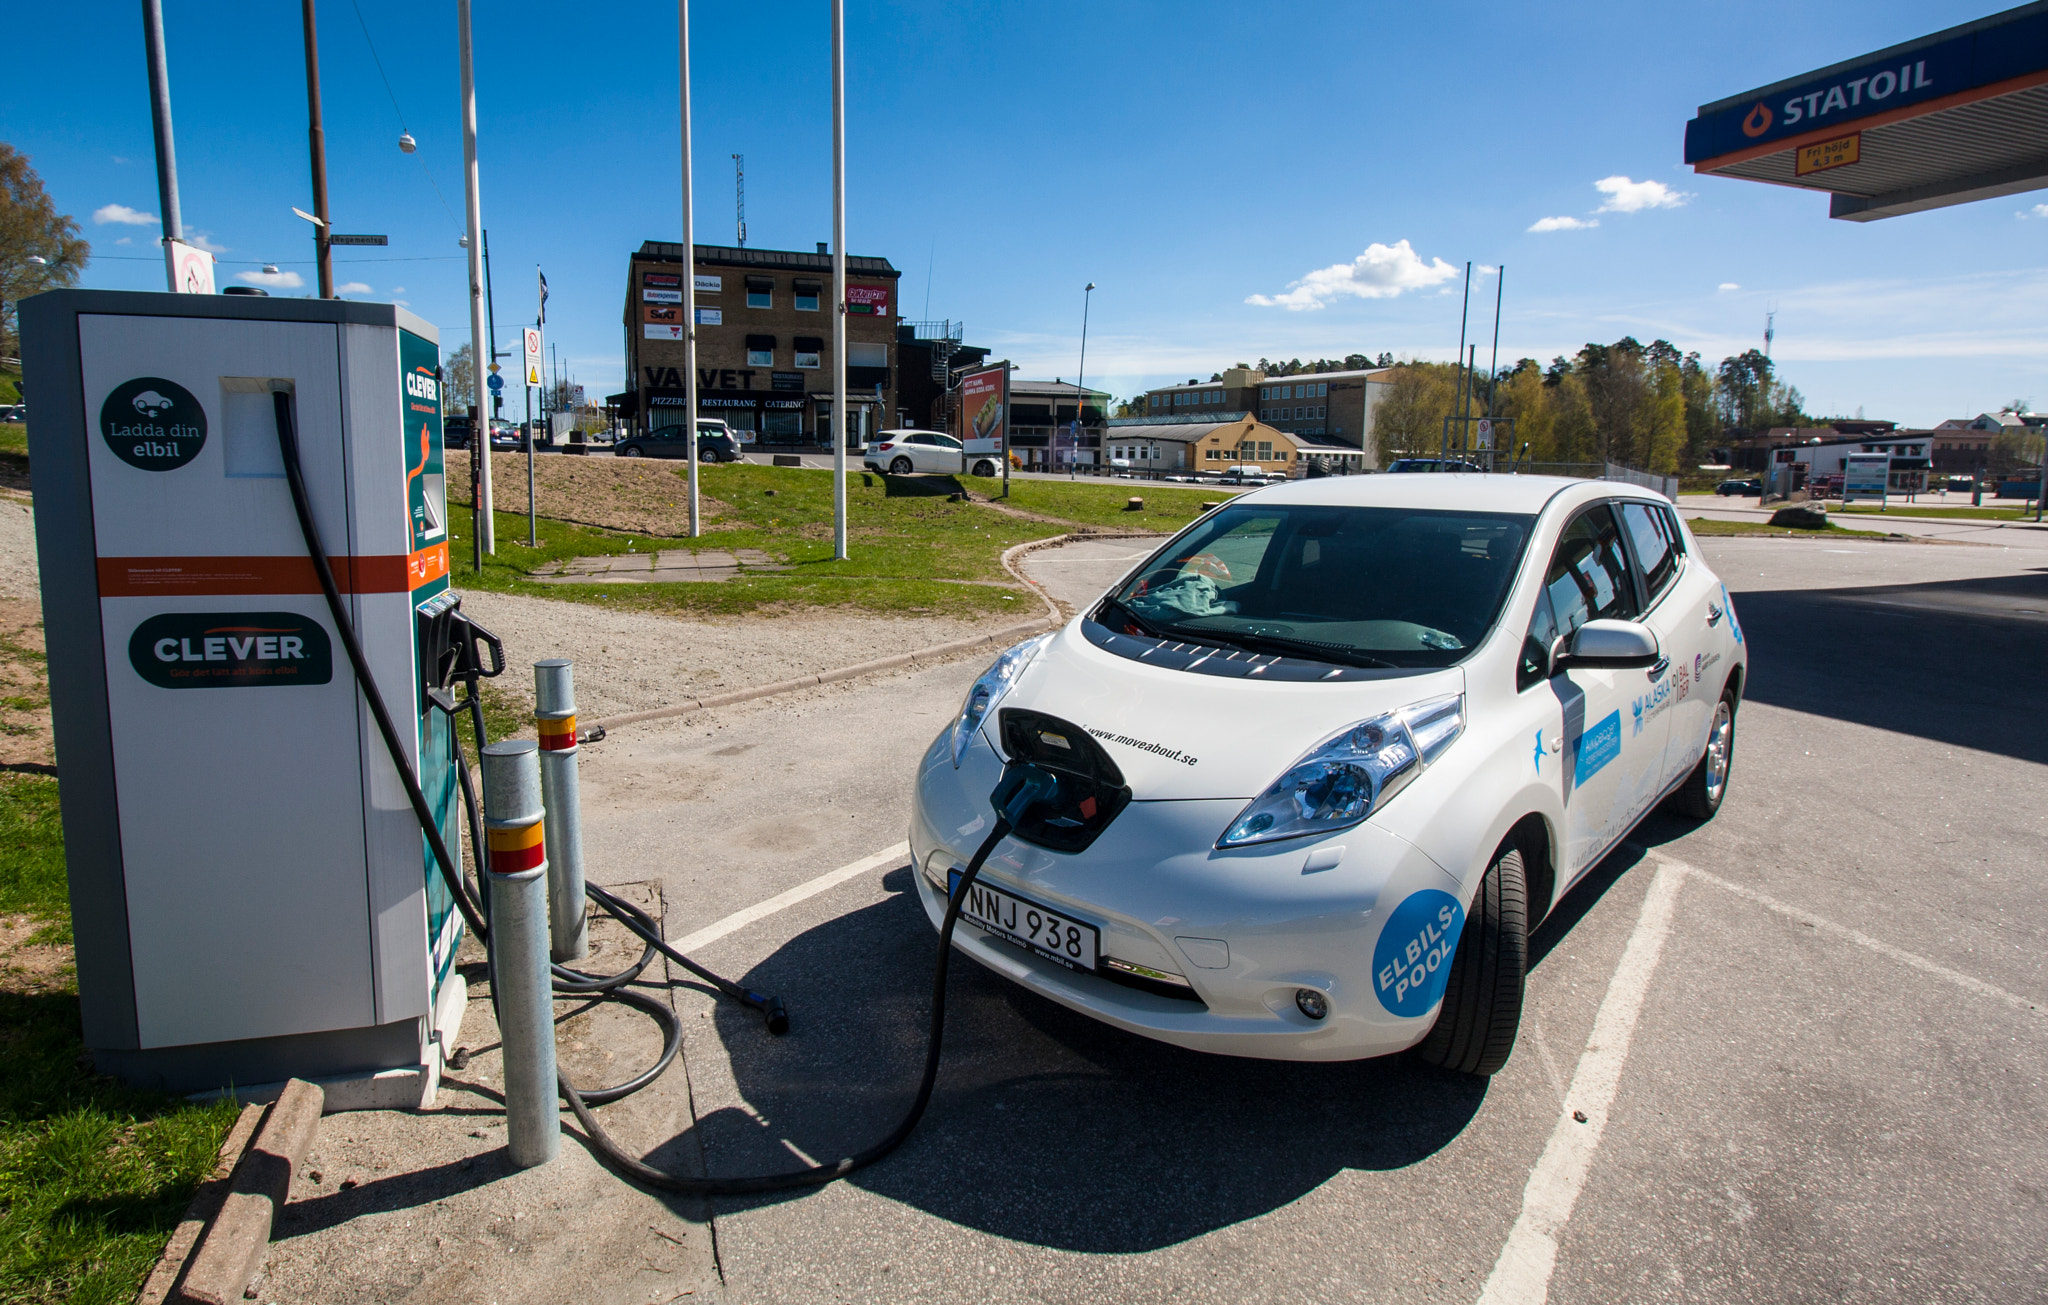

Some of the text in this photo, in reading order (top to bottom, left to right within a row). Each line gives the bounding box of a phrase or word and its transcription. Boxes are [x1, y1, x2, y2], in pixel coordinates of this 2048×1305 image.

[1783, 61, 1933, 125] STATOIL
[1806, 139, 1850, 159] Fri höjd
[1813, 154, 1843, 167] 4,3 m
[406, 371, 437, 401] CLEVER
[645, 367, 756, 389] VAVET
[652, 397, 804, 409] PIZZERI RESTAURANG CATERING
[110, 423, 200, 437] Ladda din
[133, 442, 180, 457] elbil
[154, 636, 304, 662] CLEVER
[170, 668, 190, 678] Gör
[192, 668, 209, 677] det
[232, 667, 246, 676] att
[275, 665, 298, 675] elbil
[1645, 679, 1670, 714] ALASKA
[1088, 727, 1198, 767] www.moveabout.se
[970, 884, 1082, 958] NNJ 938
[964, 913, 1074, 970] Mobility Motors Malmö www.mbil.se
[1378, 905, 1457, 991] ELBILS-
[1395, 939, 1452, 1003] POOL
